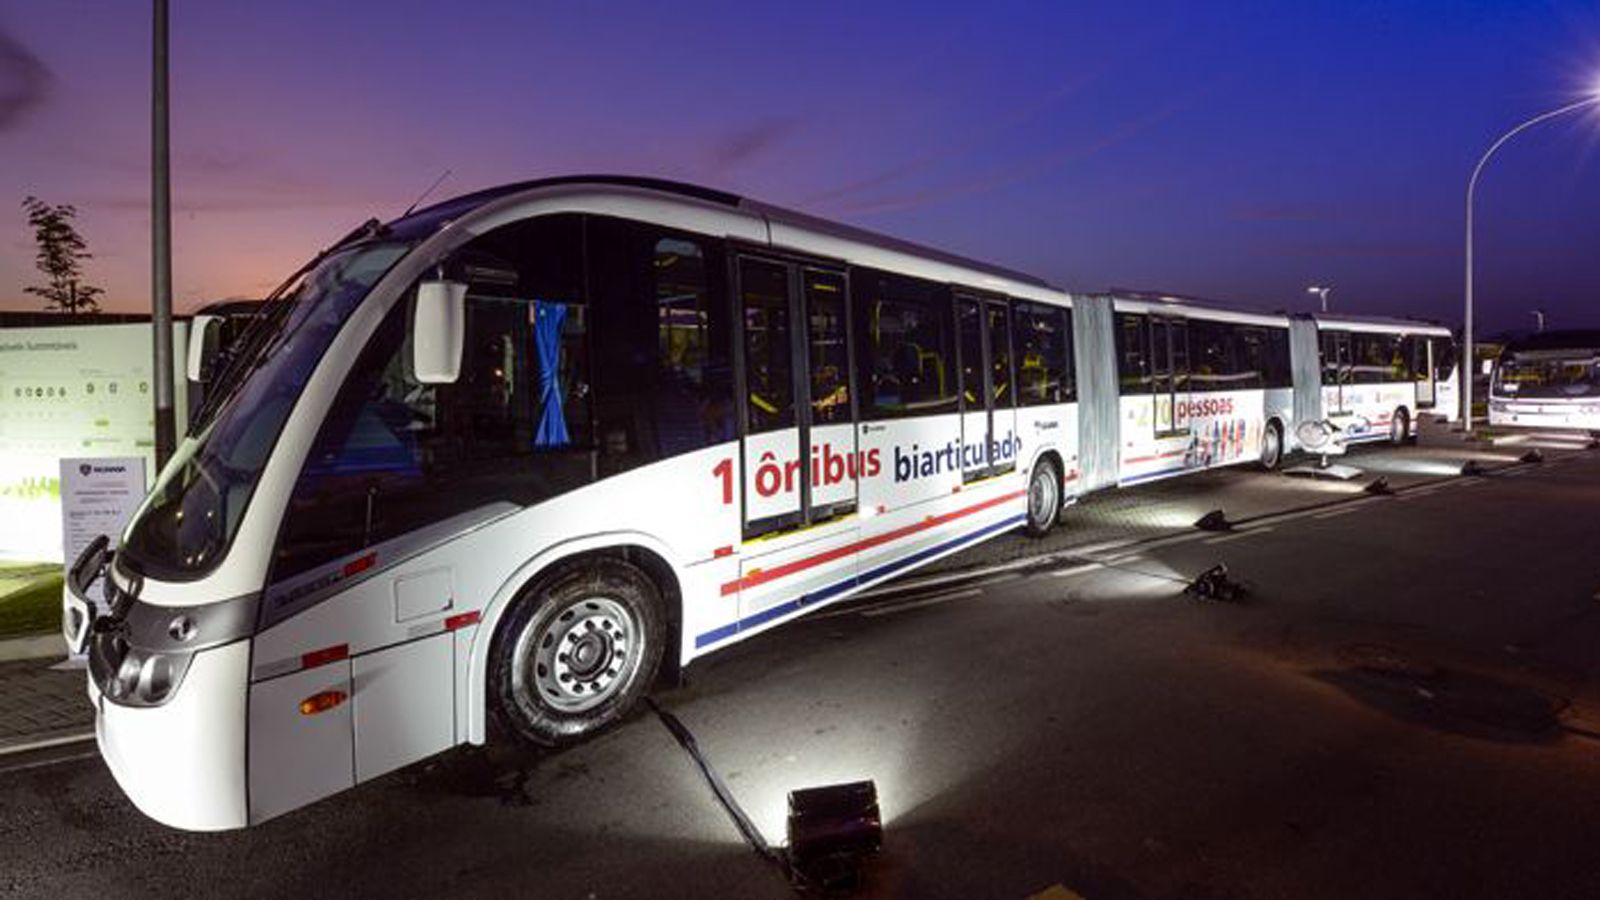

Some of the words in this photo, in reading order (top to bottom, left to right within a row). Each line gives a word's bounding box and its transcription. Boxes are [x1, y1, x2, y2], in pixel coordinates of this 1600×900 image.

[1177, 398, 1234, 425] pessoas
[712, 458, 734, 505] 1
[754, 443, 882, 498] ônibus
